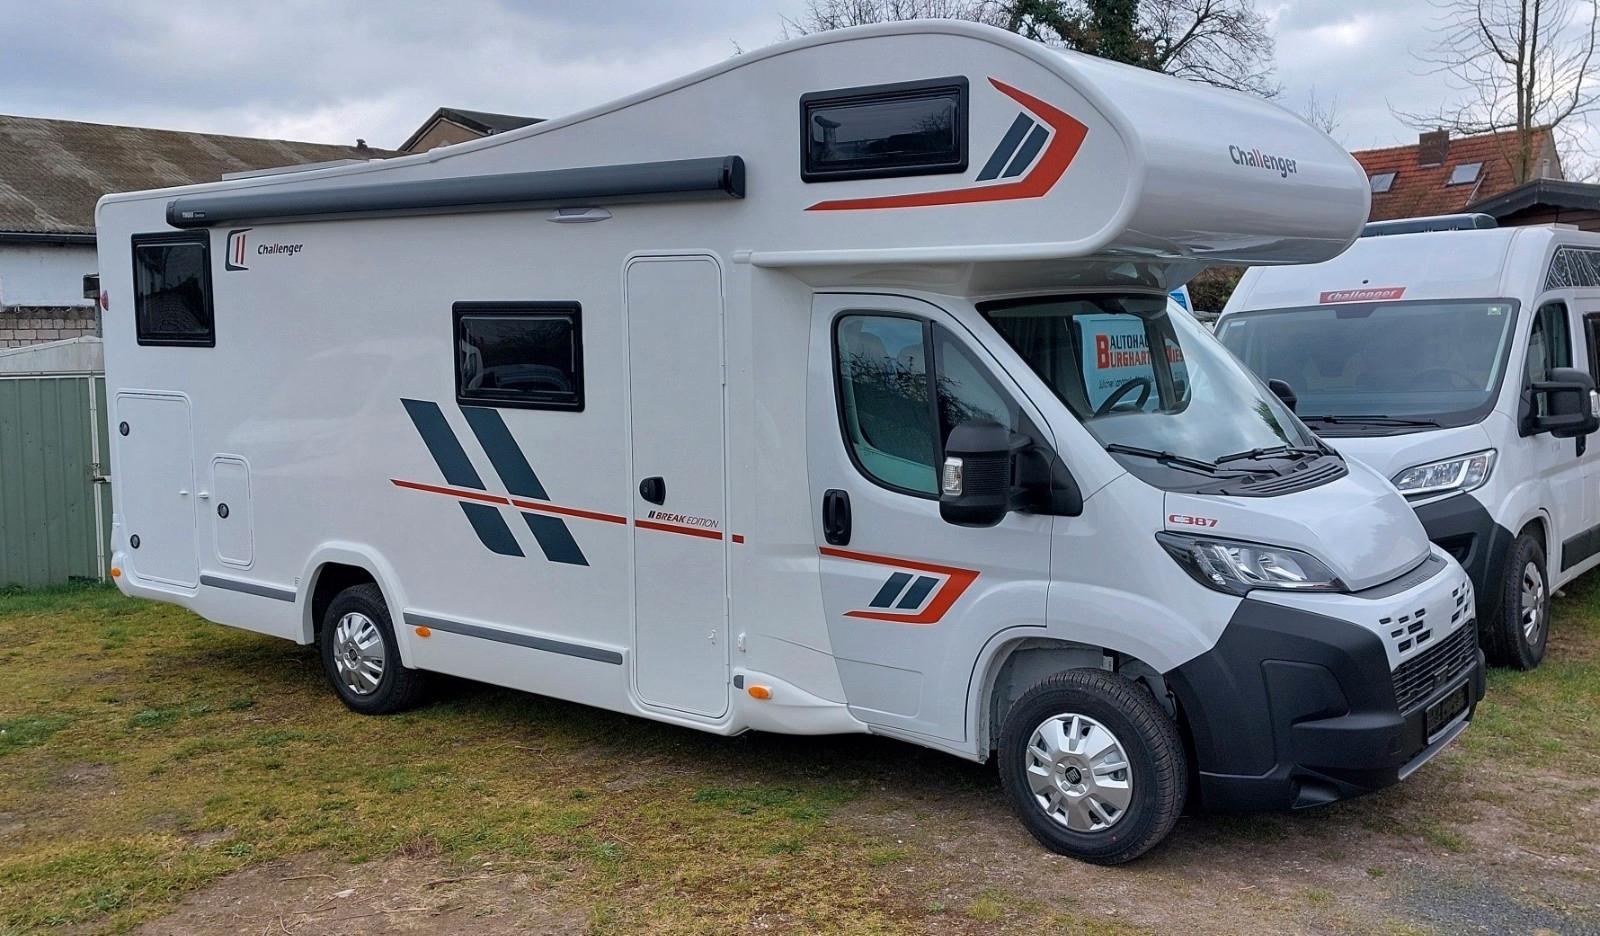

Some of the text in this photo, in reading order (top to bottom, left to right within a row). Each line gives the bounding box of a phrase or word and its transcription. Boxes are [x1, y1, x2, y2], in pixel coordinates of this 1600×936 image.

[1228, 144, 1297, 178] Challenger
[257, 243, 303, 256] Challenger
[1326, 290, 1398, 302] Challenger
[655, 512, 719, 528] BREAK EDITION
[1169, 514, 1218, 527] C387
